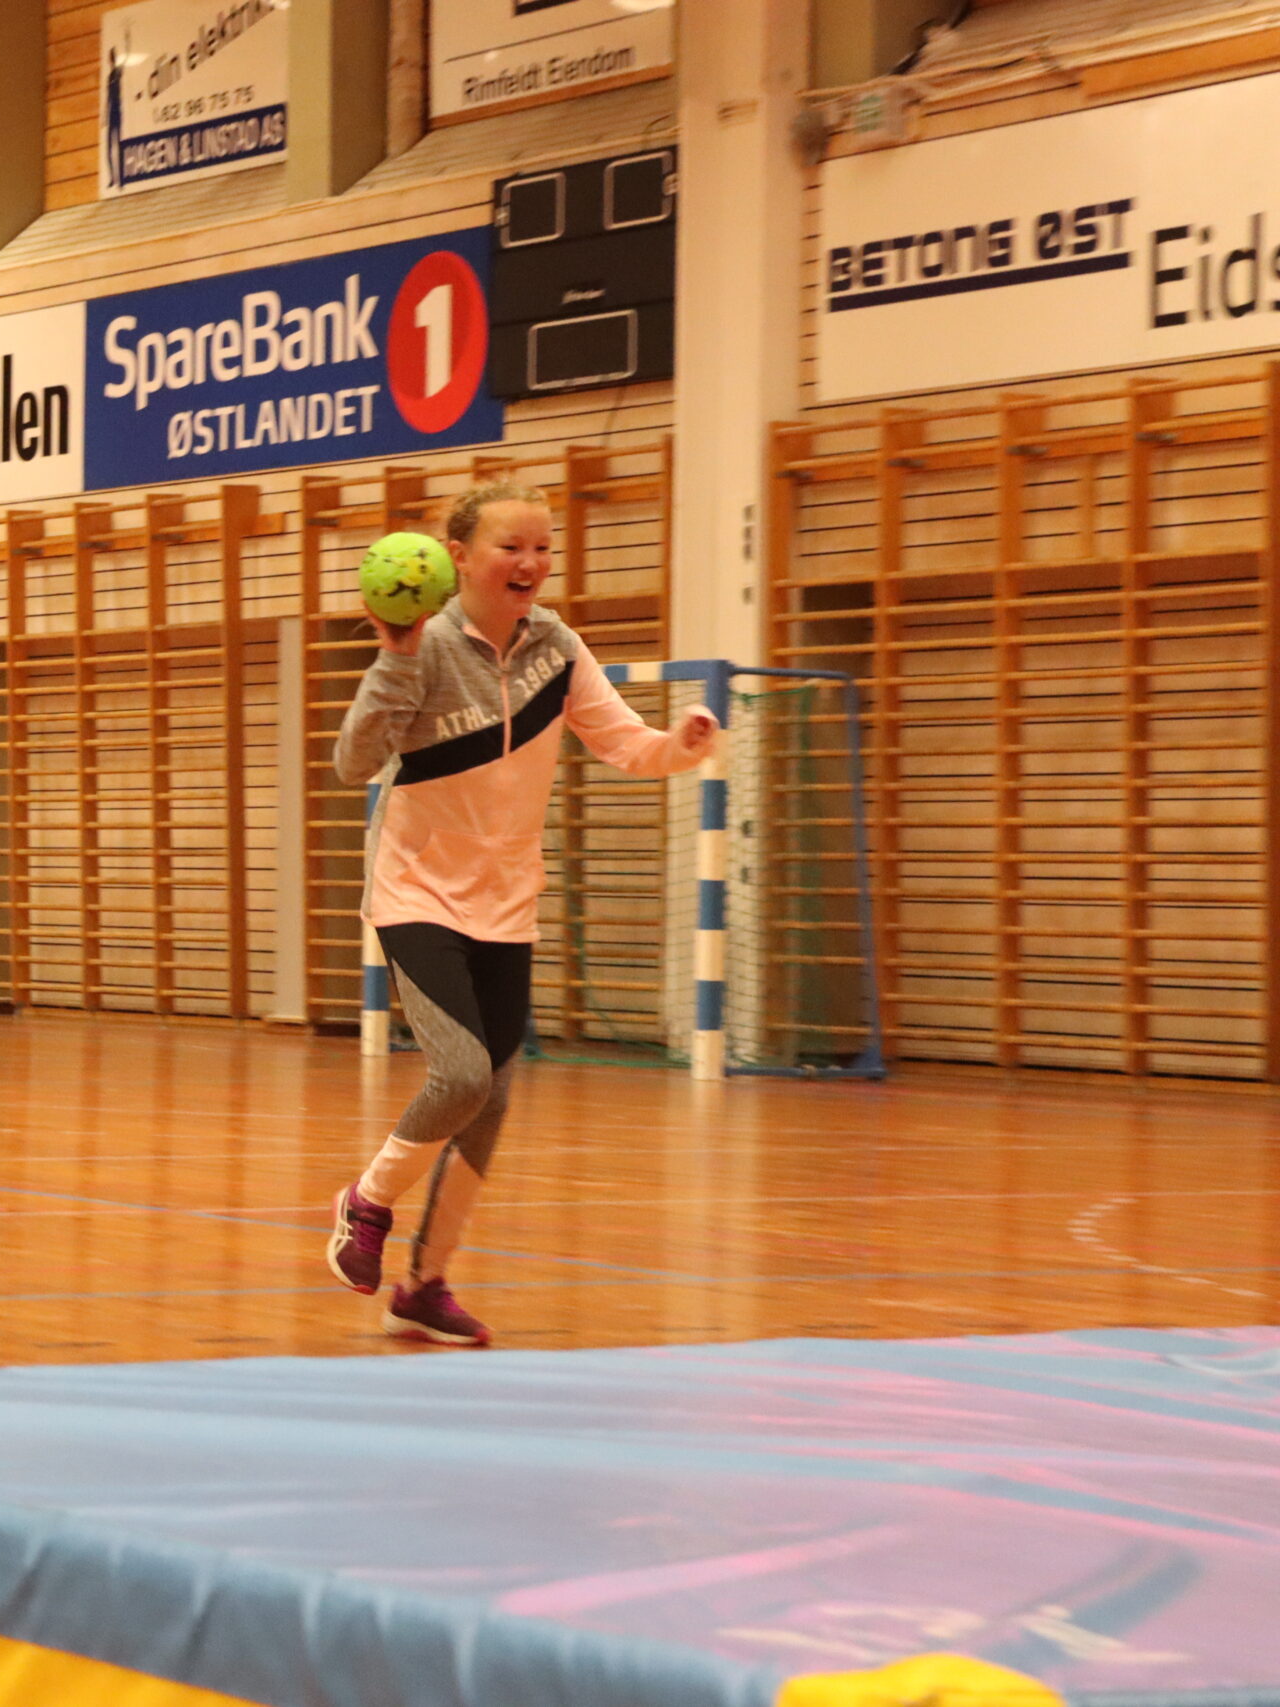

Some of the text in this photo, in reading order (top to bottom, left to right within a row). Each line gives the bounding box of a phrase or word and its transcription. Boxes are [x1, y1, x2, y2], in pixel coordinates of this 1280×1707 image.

[1034, 197, 1137, 262] ØST
[103, 272, 453, 412] SpareBank 1
[167, 384, 381, 460] ØSTLANDET
[435, 703, 499, 740] ATHL.
